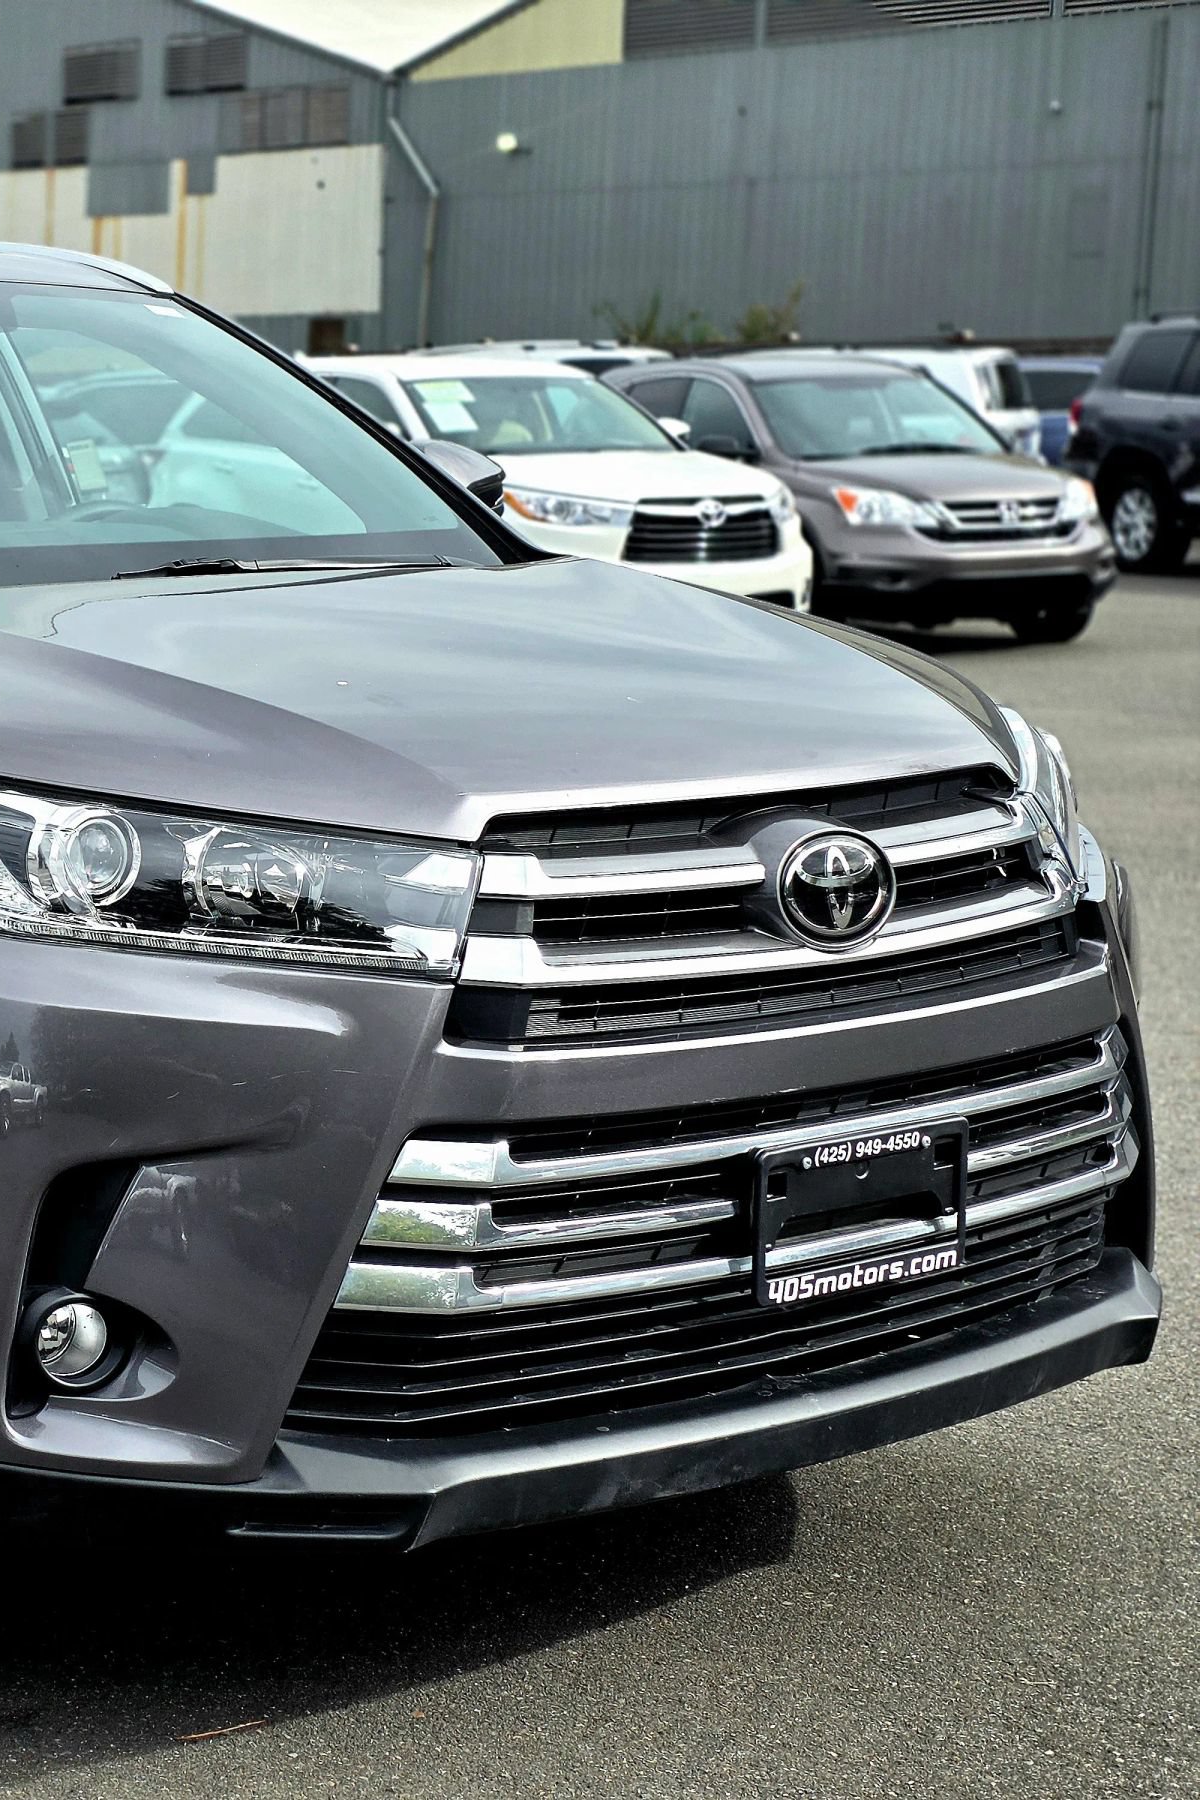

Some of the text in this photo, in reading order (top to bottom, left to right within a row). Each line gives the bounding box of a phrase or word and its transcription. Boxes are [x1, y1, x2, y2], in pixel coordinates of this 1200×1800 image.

[814, 1132, 920, 1167] (425) 949-4550
[768, 1249, 957, 1304] 405motors.com
